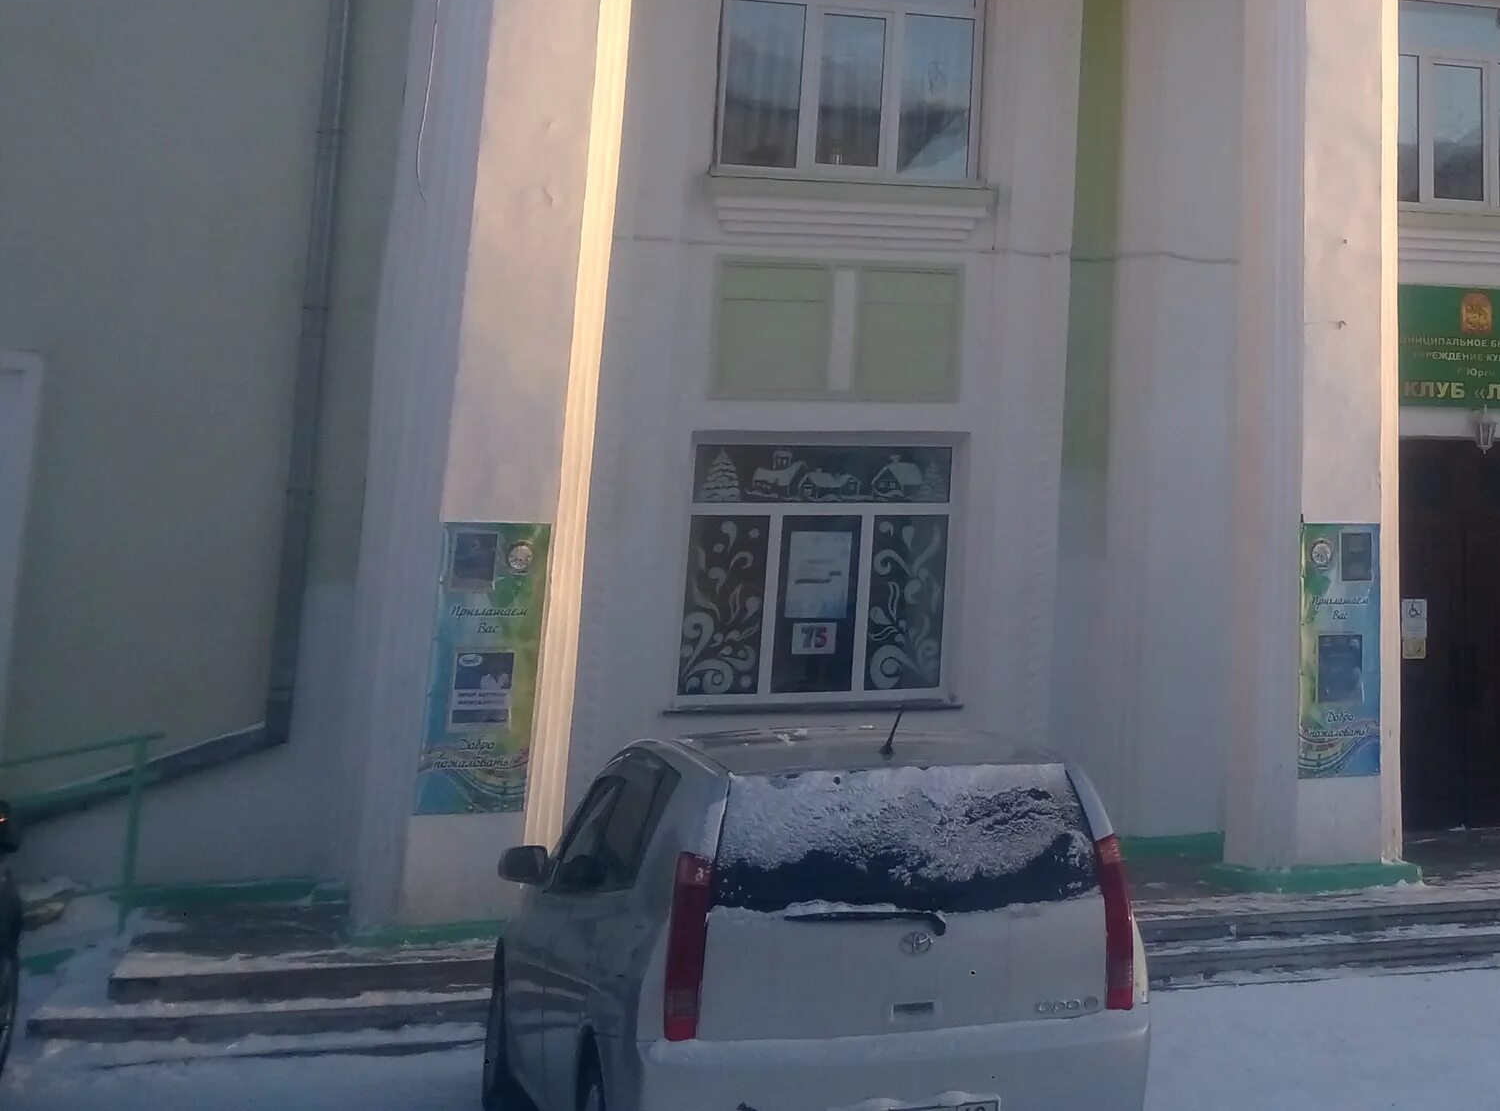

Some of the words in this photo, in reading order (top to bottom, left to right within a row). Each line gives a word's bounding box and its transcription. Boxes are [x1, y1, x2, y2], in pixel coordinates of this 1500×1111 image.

[1400, 336, 1488, 347] УНИЦИПАЛЬНОЕ
[1403, 380, 1466, 399] КЛУБ
[451, 605, 528, 619] Приглашаем
[477, 621, 500, 634] Вас
[801, 626, 828, 649] 75
[459, 737, 495, 755] Добро
